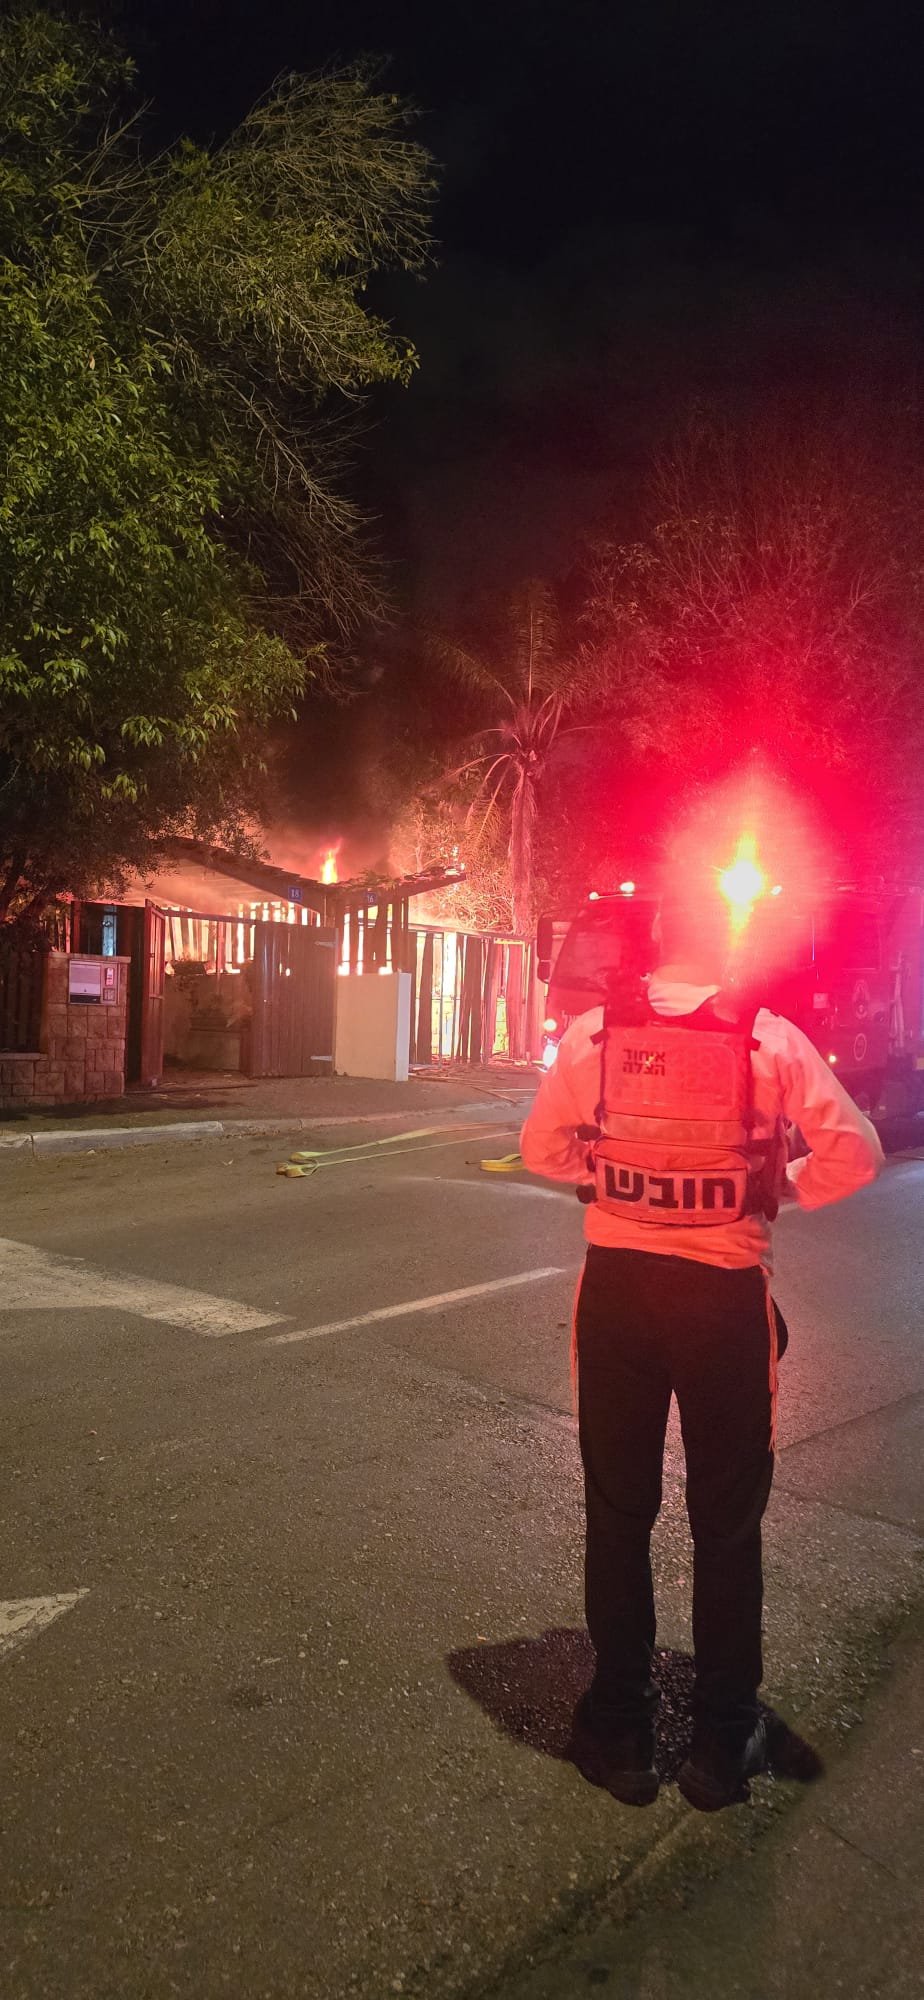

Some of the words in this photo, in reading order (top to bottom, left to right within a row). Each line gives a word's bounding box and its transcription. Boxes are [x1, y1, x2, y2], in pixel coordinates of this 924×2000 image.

[623, 1048, 666, 1063] איחוד
[623, 1061, 666, 1077] הצלה
[604, 1164, 737, 1210] חובש
